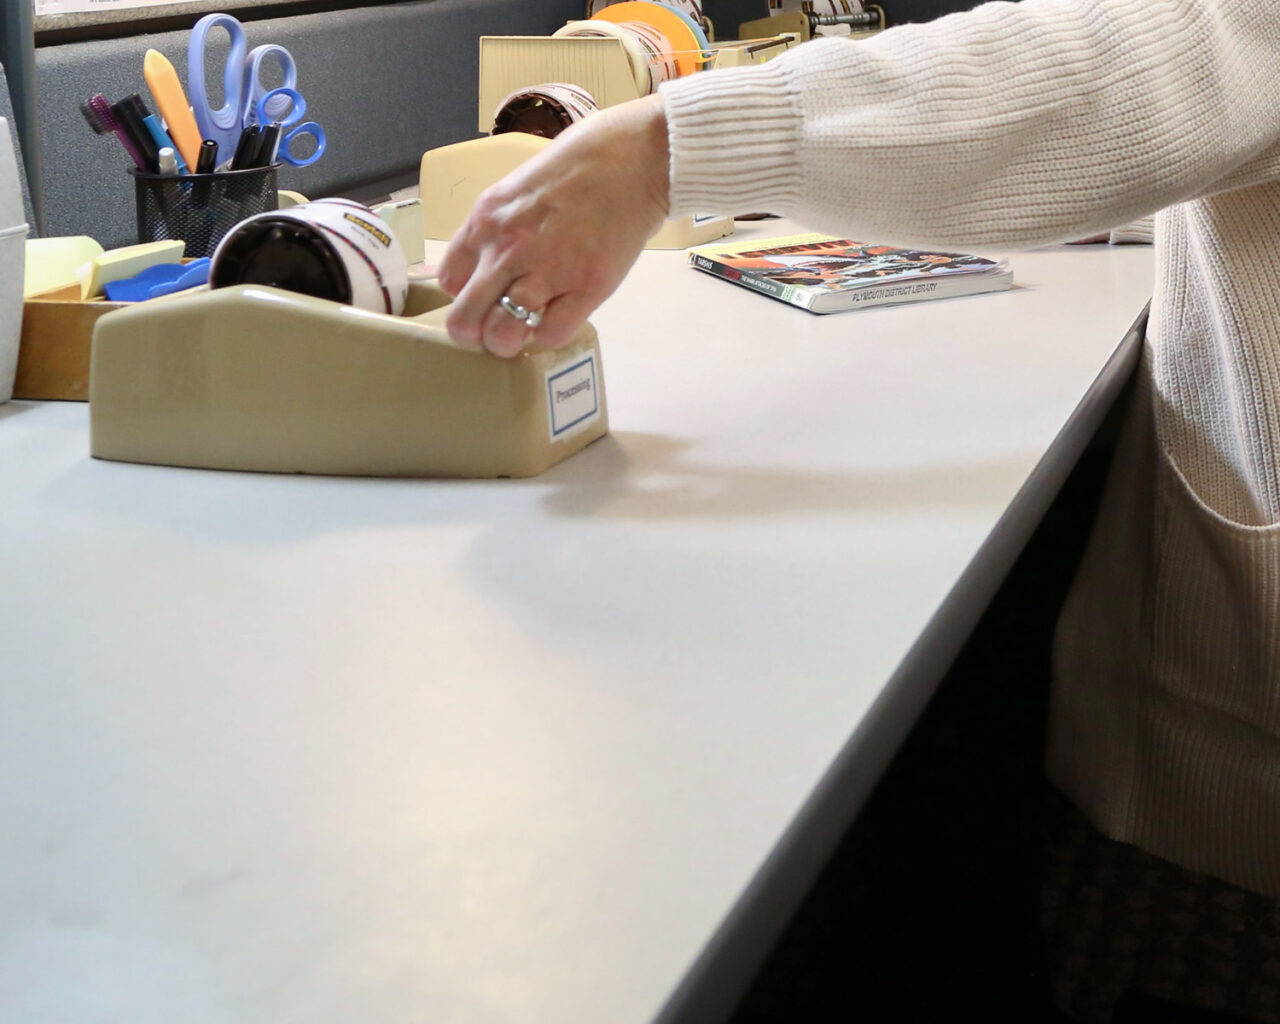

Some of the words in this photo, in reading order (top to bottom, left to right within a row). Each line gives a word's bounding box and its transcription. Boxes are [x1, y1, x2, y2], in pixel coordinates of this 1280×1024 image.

[851, 288, 885, 302] PLYMOUTH
[884, 285, 912, 297] DISTRICT
[911, 282, 938, 296] LIBRARY
[555, 377, 592, 404] Processing
